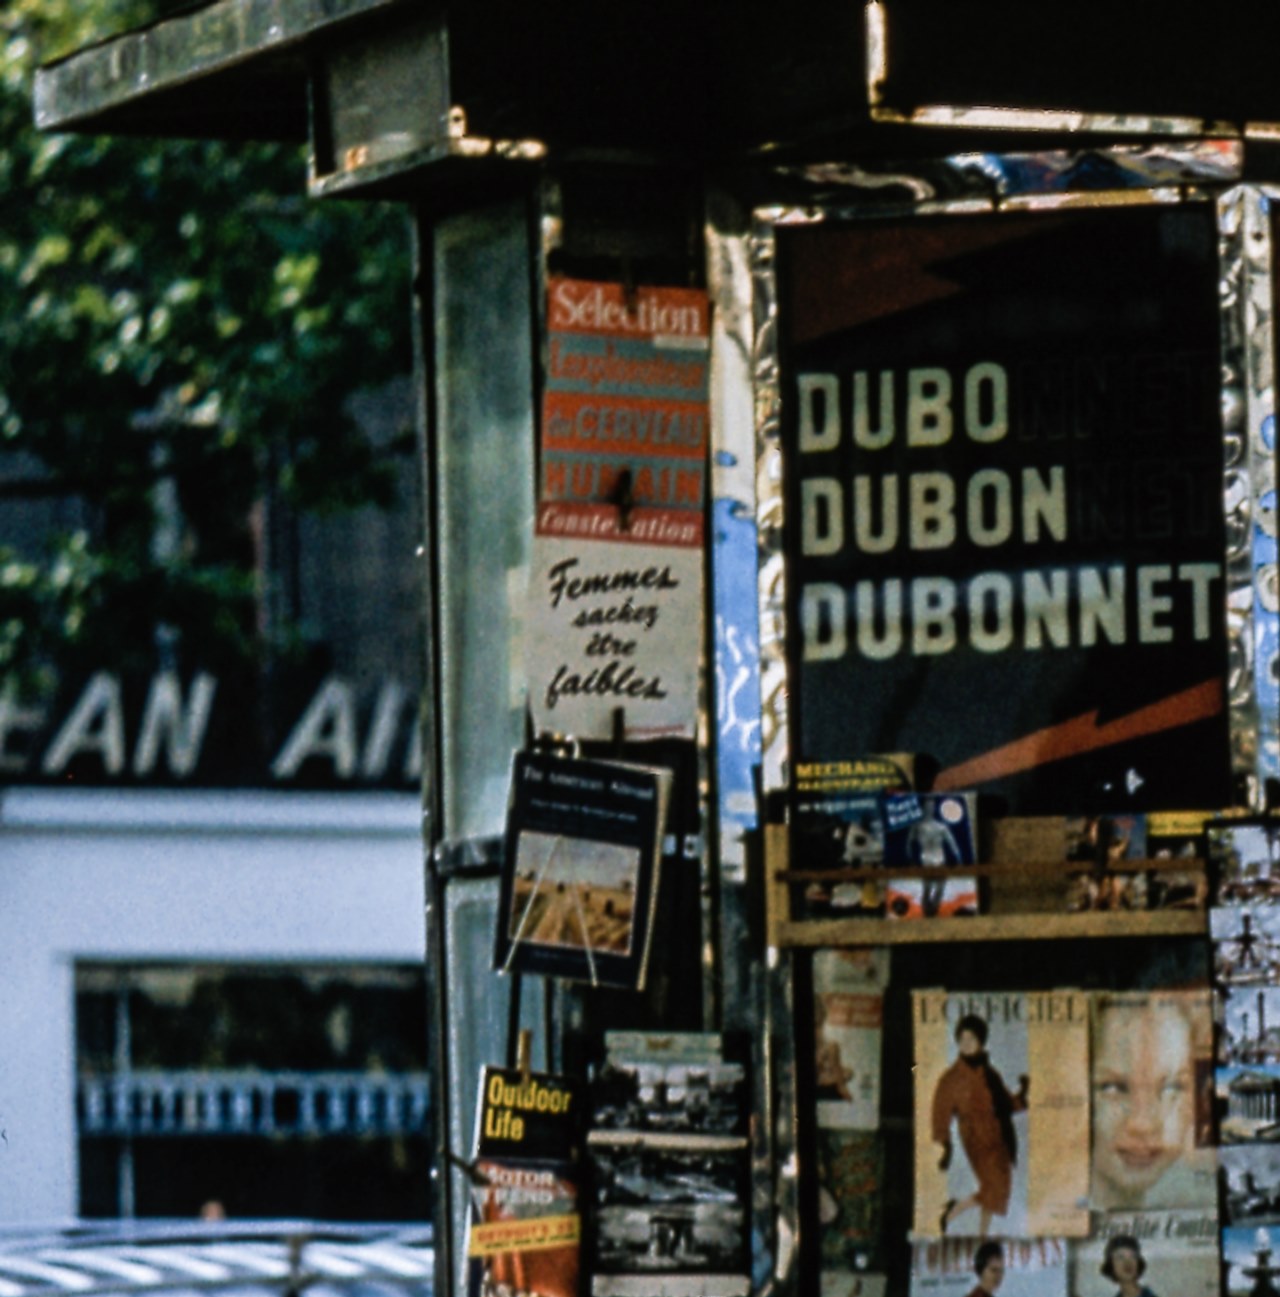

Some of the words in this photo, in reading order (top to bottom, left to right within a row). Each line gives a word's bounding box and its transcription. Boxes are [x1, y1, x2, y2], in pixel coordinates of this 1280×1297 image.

[574, 406, 705, 446] CERVEAU
[797, 362, 1009, 452] DUBO
[545, 460, 700, 505] HUAIN
[799, 466, 1066, 556] DUBON
[549, 558, 679, 609] Femmes
[571, 597, 658, 630] sachez
[801, 563, 1221, 662] DUBONNET
[546, 660, 668, 710] faibles
[487, 1075, 572, 1114] Outdoor
[485, 1107, 525, 1141] Life
